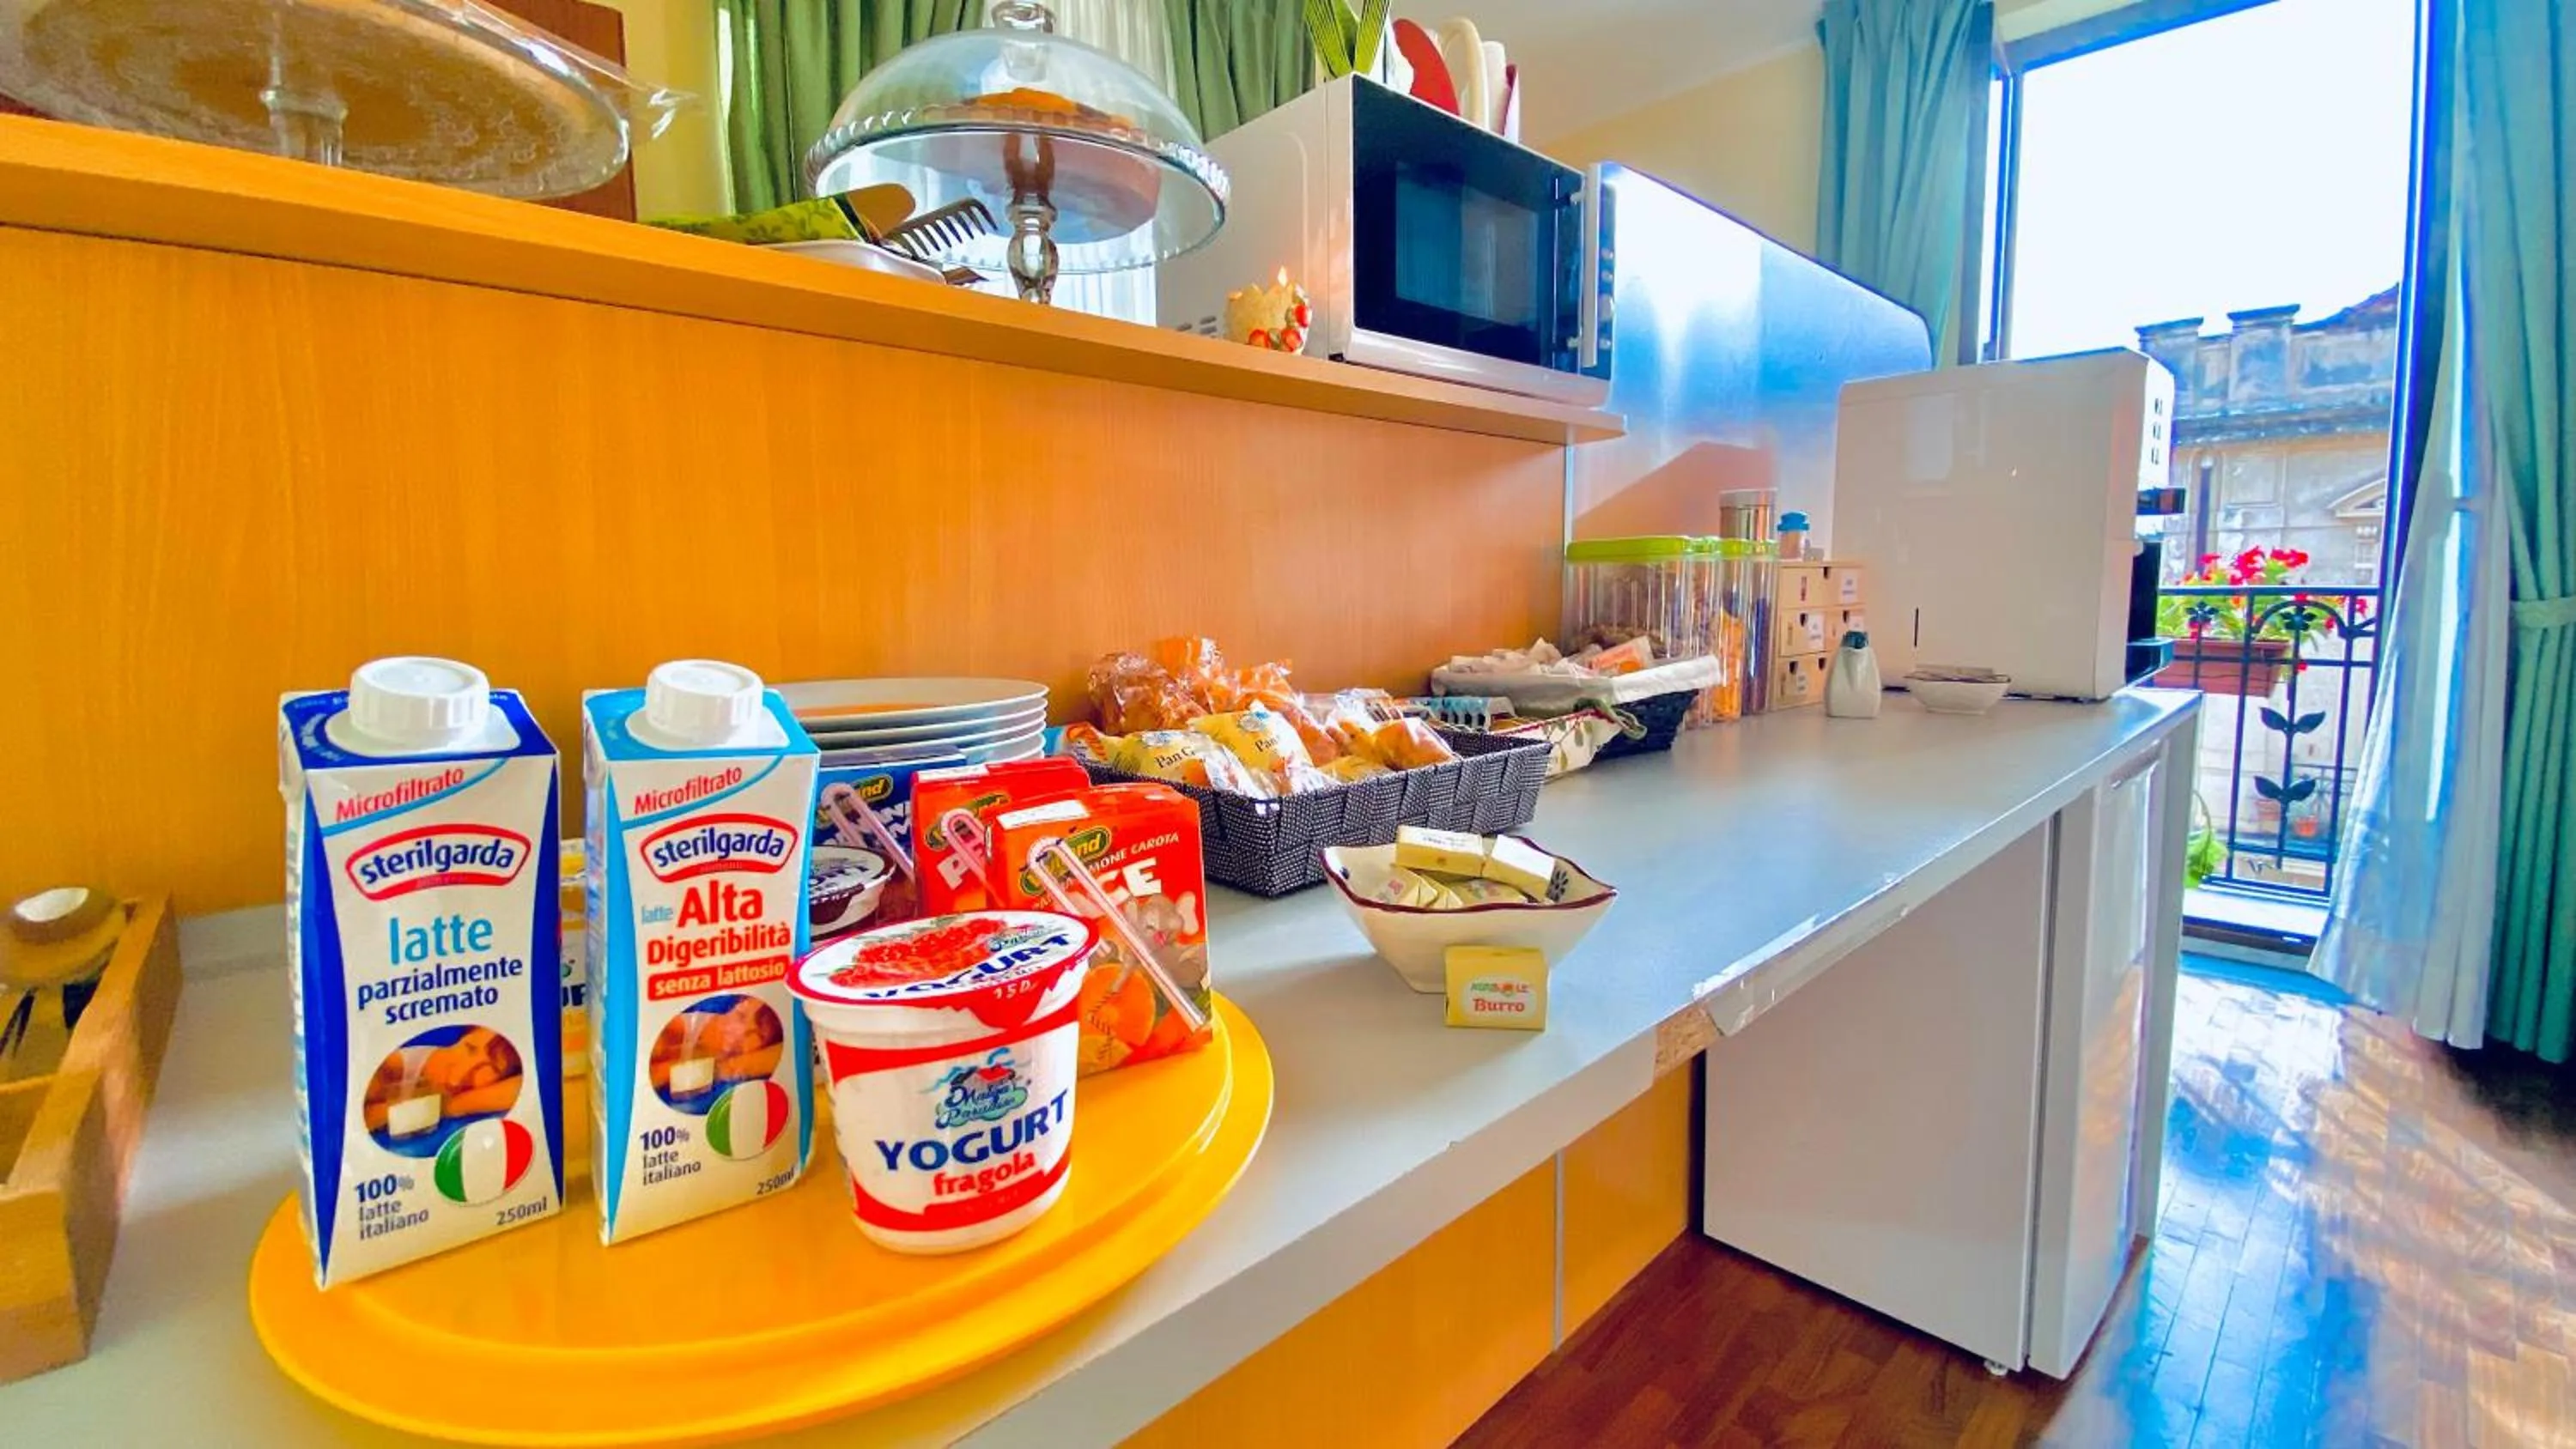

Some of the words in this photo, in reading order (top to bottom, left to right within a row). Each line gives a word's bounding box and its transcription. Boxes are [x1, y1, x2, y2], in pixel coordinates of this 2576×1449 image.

[336, 767, 465, 821] Microfiltrato
[634, 766, 743, 815] Microfiltrato
[359, 838, 515, 885] sterilgarda
[653, 826, 785, 868] sterilgarda
[1130, 832, 1180, 855] CAROTA
[641, 904, 674, 925] latte
[677, 880, 763, 928] Alta
[389, 915, 493, 966] latte
[646, 922, 792, 967] Digeribilità
[358, 955, 523, 1010] parzialmente
[653, 975, 713, 997] senza
[717, 961, 786, 986] lattosio
[385, 986, 500, 1025] scremato
[1473, 998, 1525, 1013] Burro
[640, 1126, 690, 1152] 100%
[874, 1089, 1069, 1172] YOGURT
[641, 1160, 702, 1185] italiano
[642, 1150, 679, 1170] latte
[933, 1150, 1036, 1197] fragola
[355, 1173, 414, 1203] 100%
[756, 1167, 795, 1197] 250ml
[358, 1198, 402, 1222] latte
[359, 1207, 429, 1240] italiano
[496, 1198, 548, 1227] 250ml
